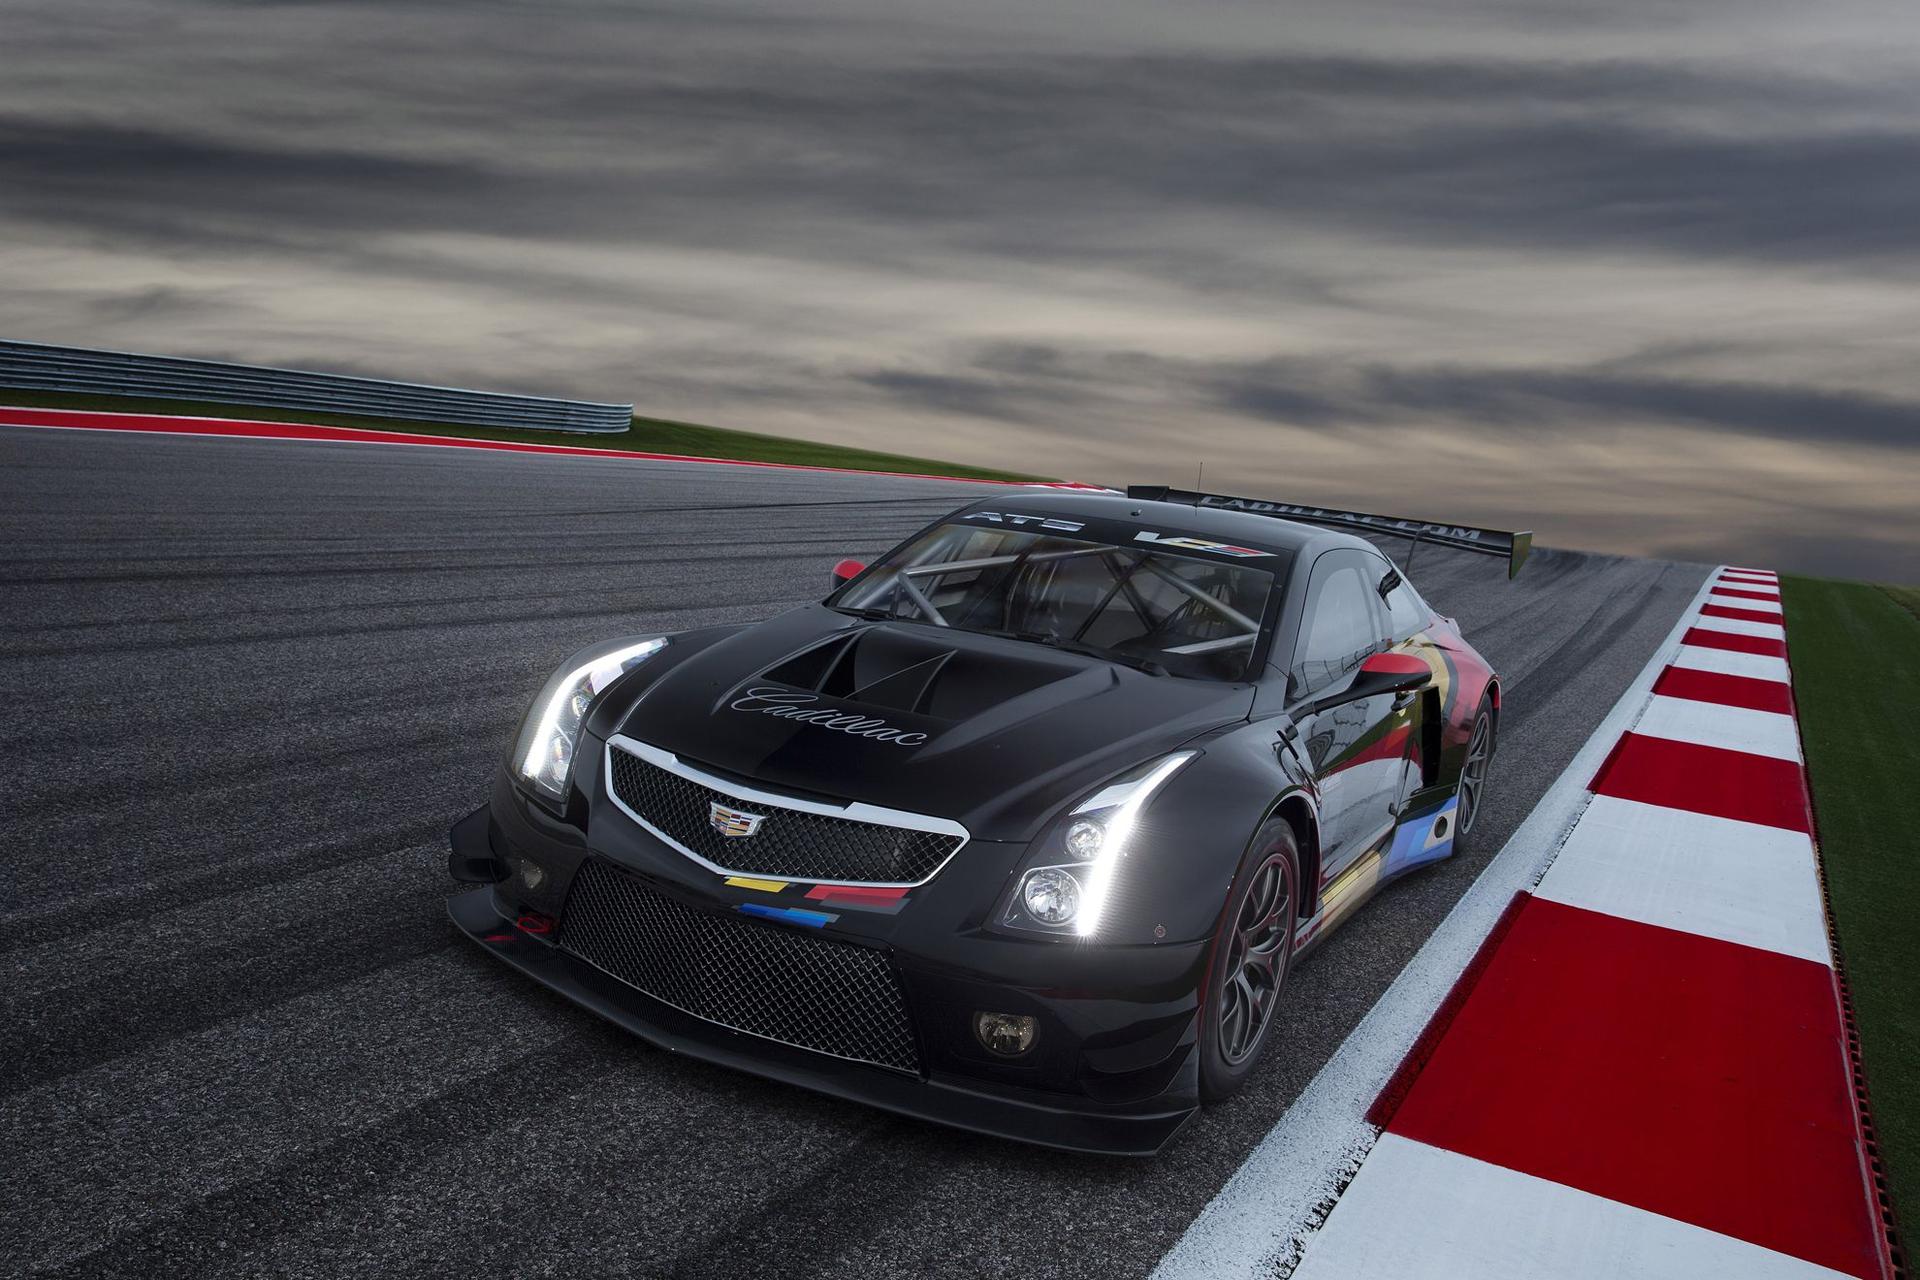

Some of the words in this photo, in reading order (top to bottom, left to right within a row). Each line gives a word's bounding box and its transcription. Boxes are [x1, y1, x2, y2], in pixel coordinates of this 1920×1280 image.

[962, 511, 1086, 532] ATS
[1200, 496, 1481, 540] CADILLAC.COM
[730, 687, 928, 746] Cadillac
